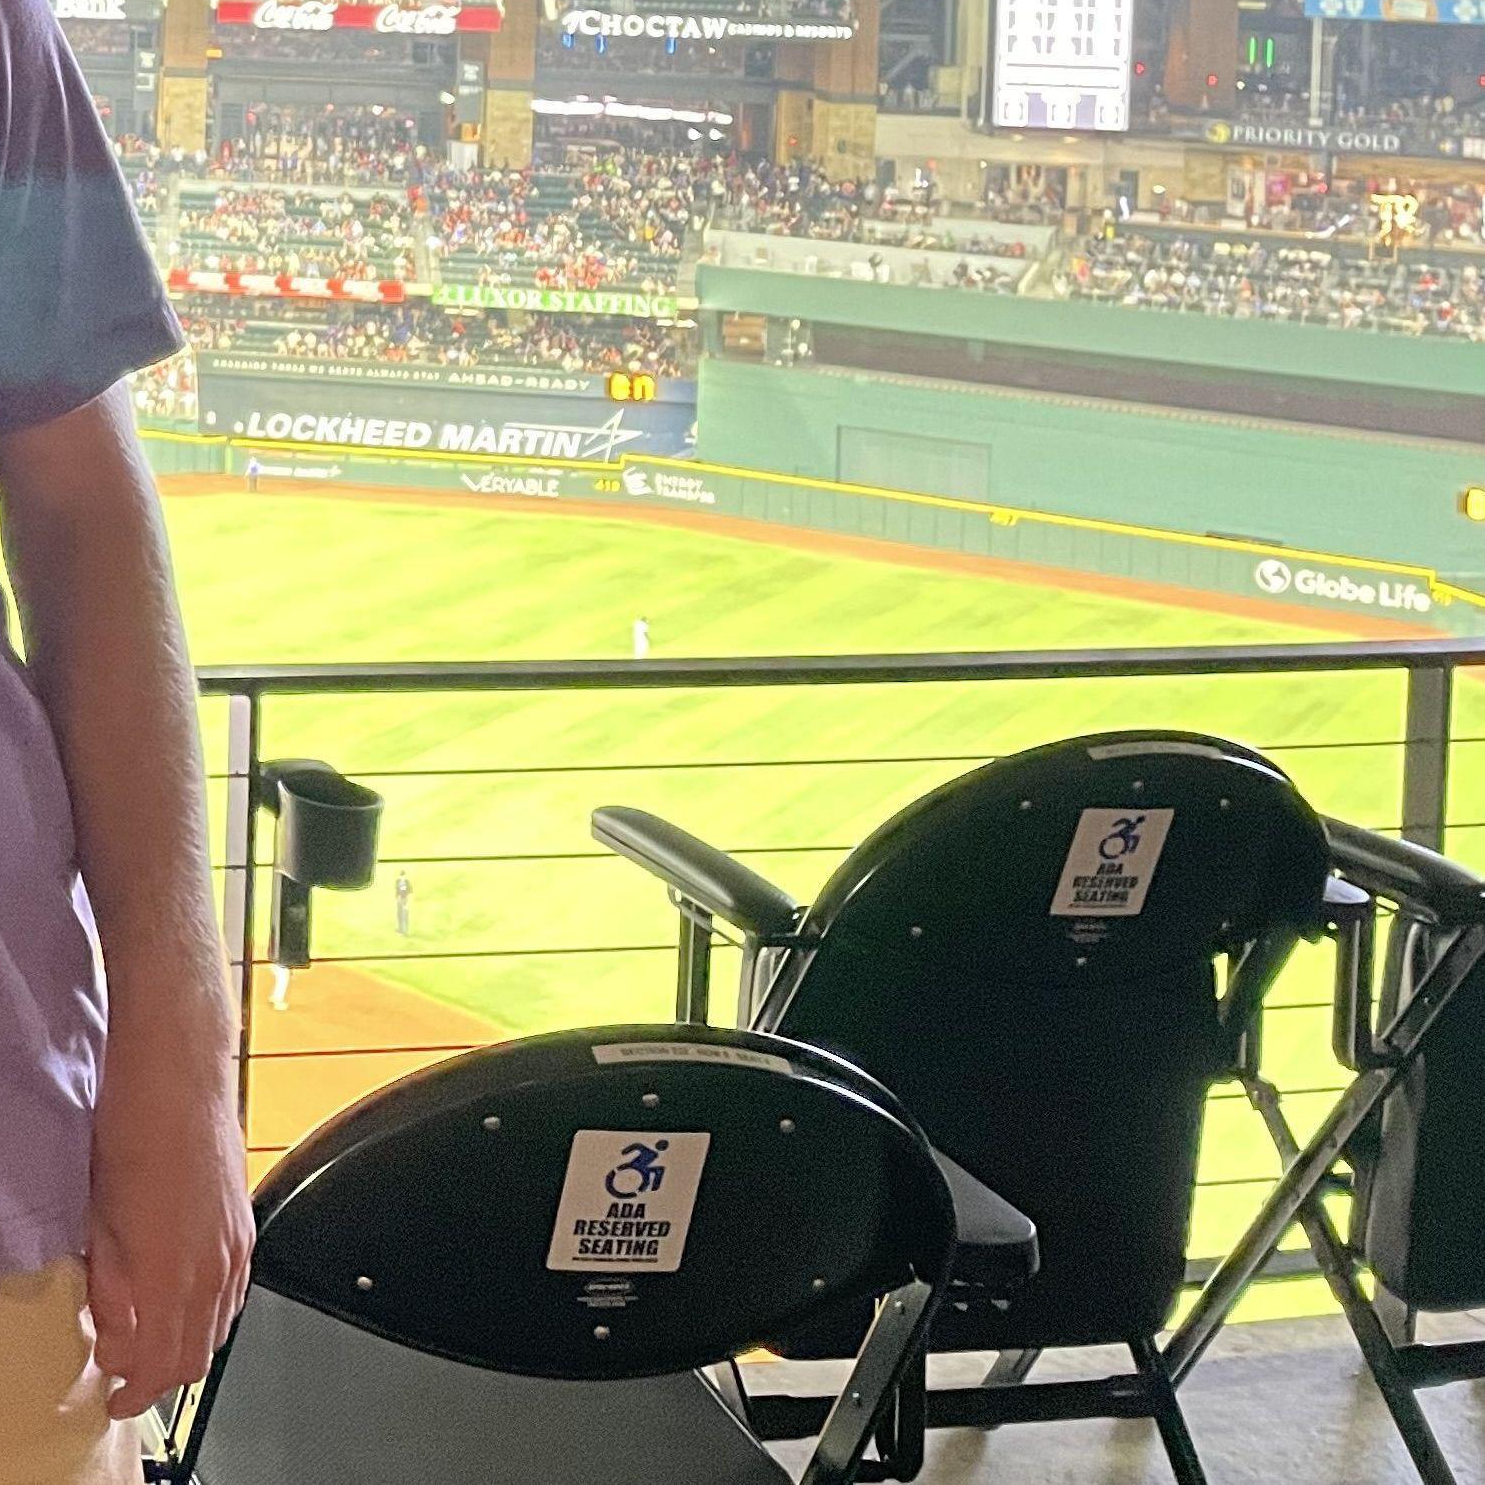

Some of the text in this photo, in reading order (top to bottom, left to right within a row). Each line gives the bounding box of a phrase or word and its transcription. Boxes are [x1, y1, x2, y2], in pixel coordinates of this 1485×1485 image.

[579, 9, 728, 40] CHOCTAW
[1233, 125, 1401, 152] PRIORITY GOLD
[247, 412, 583, 458] LOCKHEED MARTIN
[1294, 568, 1376, 604] Globe
[1378, 581, 1432, 613] Life
[606, 1202, 646, 1219] ADA
[573, 1219, 672, 1237] RESERVED
[578, 1238, 660, 1256] SEATING
